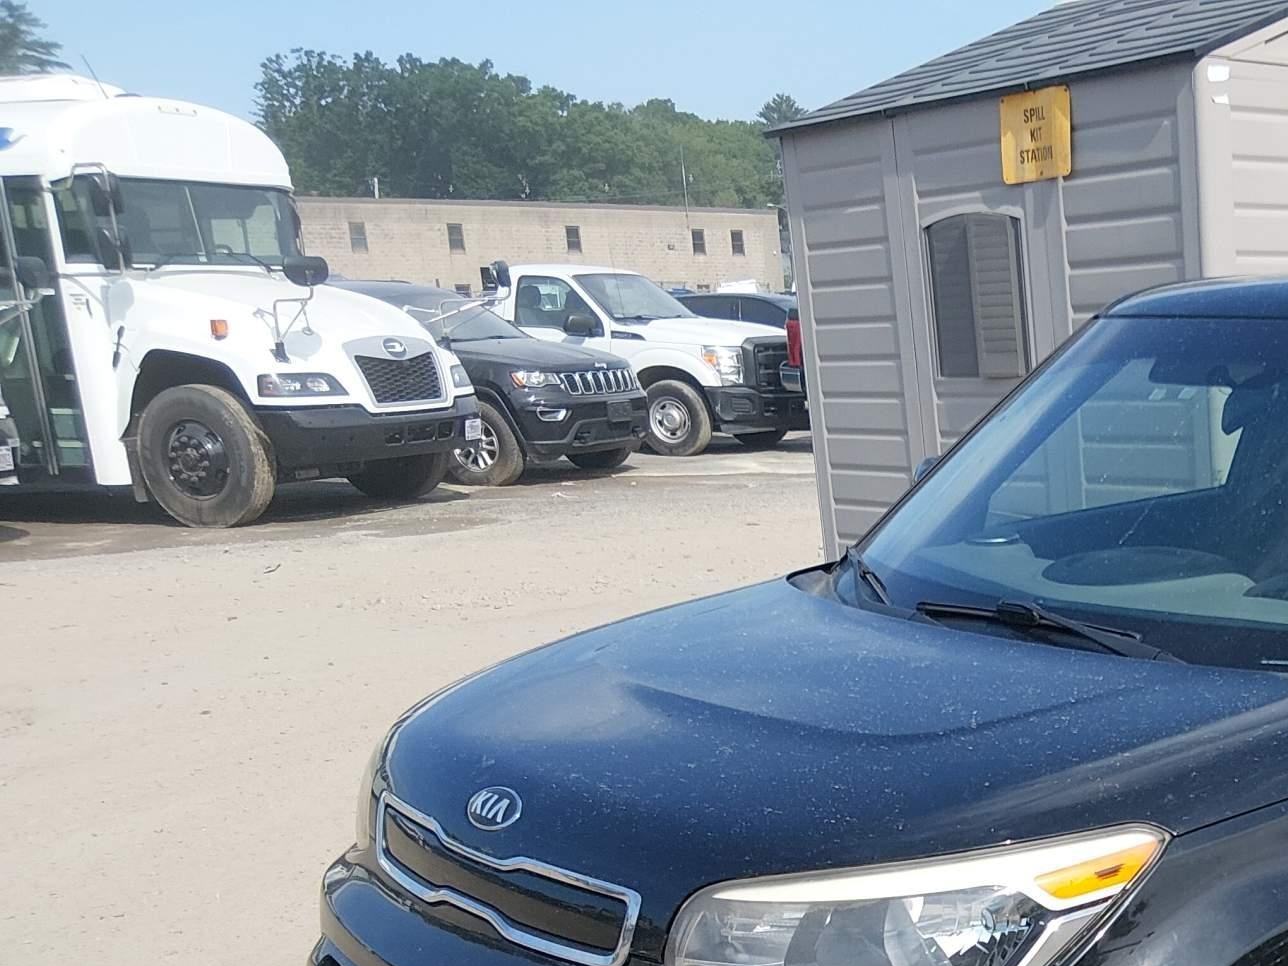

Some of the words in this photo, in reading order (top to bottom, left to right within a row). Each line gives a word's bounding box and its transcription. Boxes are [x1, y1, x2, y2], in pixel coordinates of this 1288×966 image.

[1023, 106, 1045, 123] SPILL
[1030, 127, 1042, 142] KIT
[1020, 145, 1053, 164] STATION
[471, 791, 510, 823] KIA
